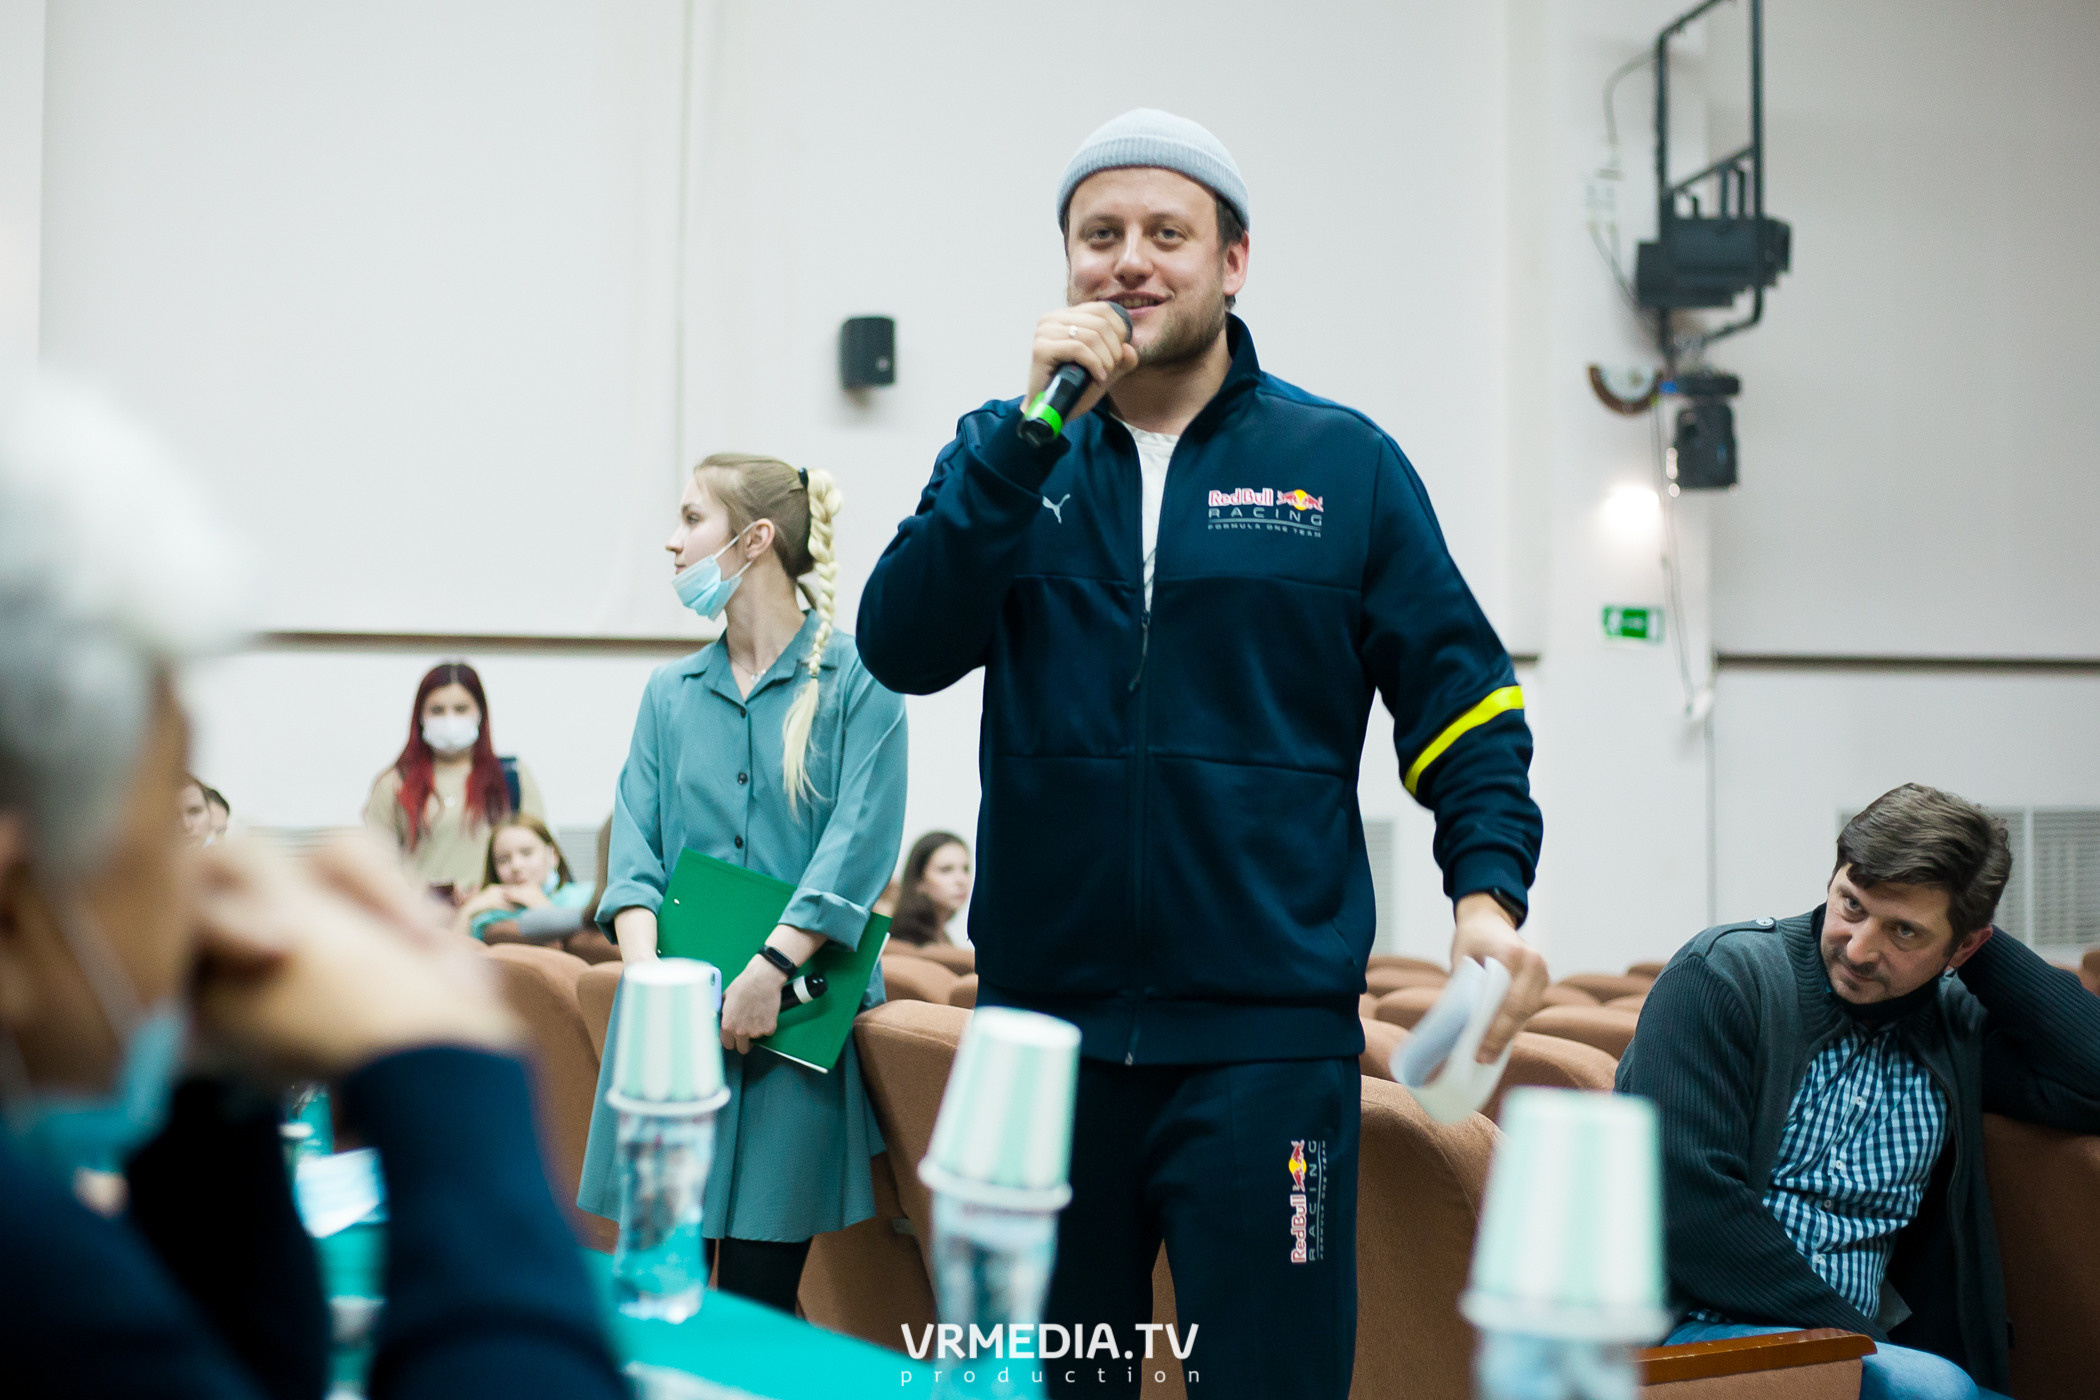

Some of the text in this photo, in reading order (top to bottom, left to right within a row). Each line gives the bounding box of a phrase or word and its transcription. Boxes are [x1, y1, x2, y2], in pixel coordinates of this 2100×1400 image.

[1208, 507, 1323, 526] RACING
[1266, 524, 1288, 533] ONE
[1308, 1140, 1317, 1261] RACING
